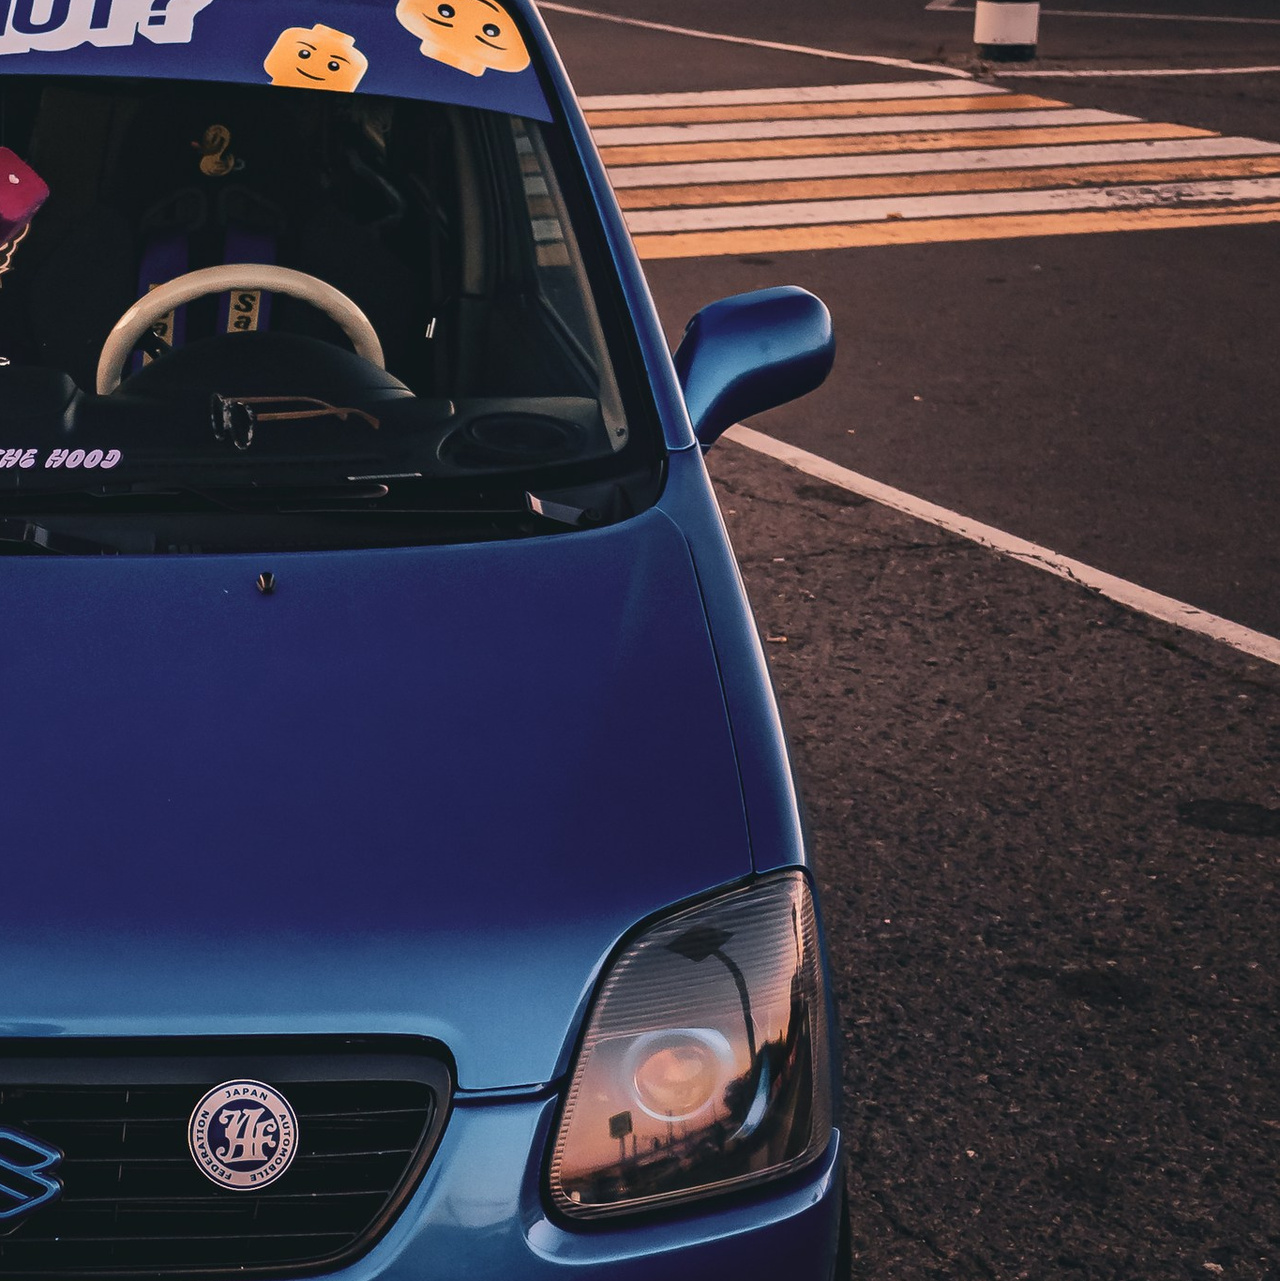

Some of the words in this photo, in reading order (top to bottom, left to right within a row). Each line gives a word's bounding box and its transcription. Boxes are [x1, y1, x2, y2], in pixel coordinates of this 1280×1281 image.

[45, 449, 122, 469] HOOD
[225, 1087, 269, 1101] JAPAN
[197, 1110, 233, 1181] FEDERATION
[250, 1114, 291, 1182] AUTOMOBILE
